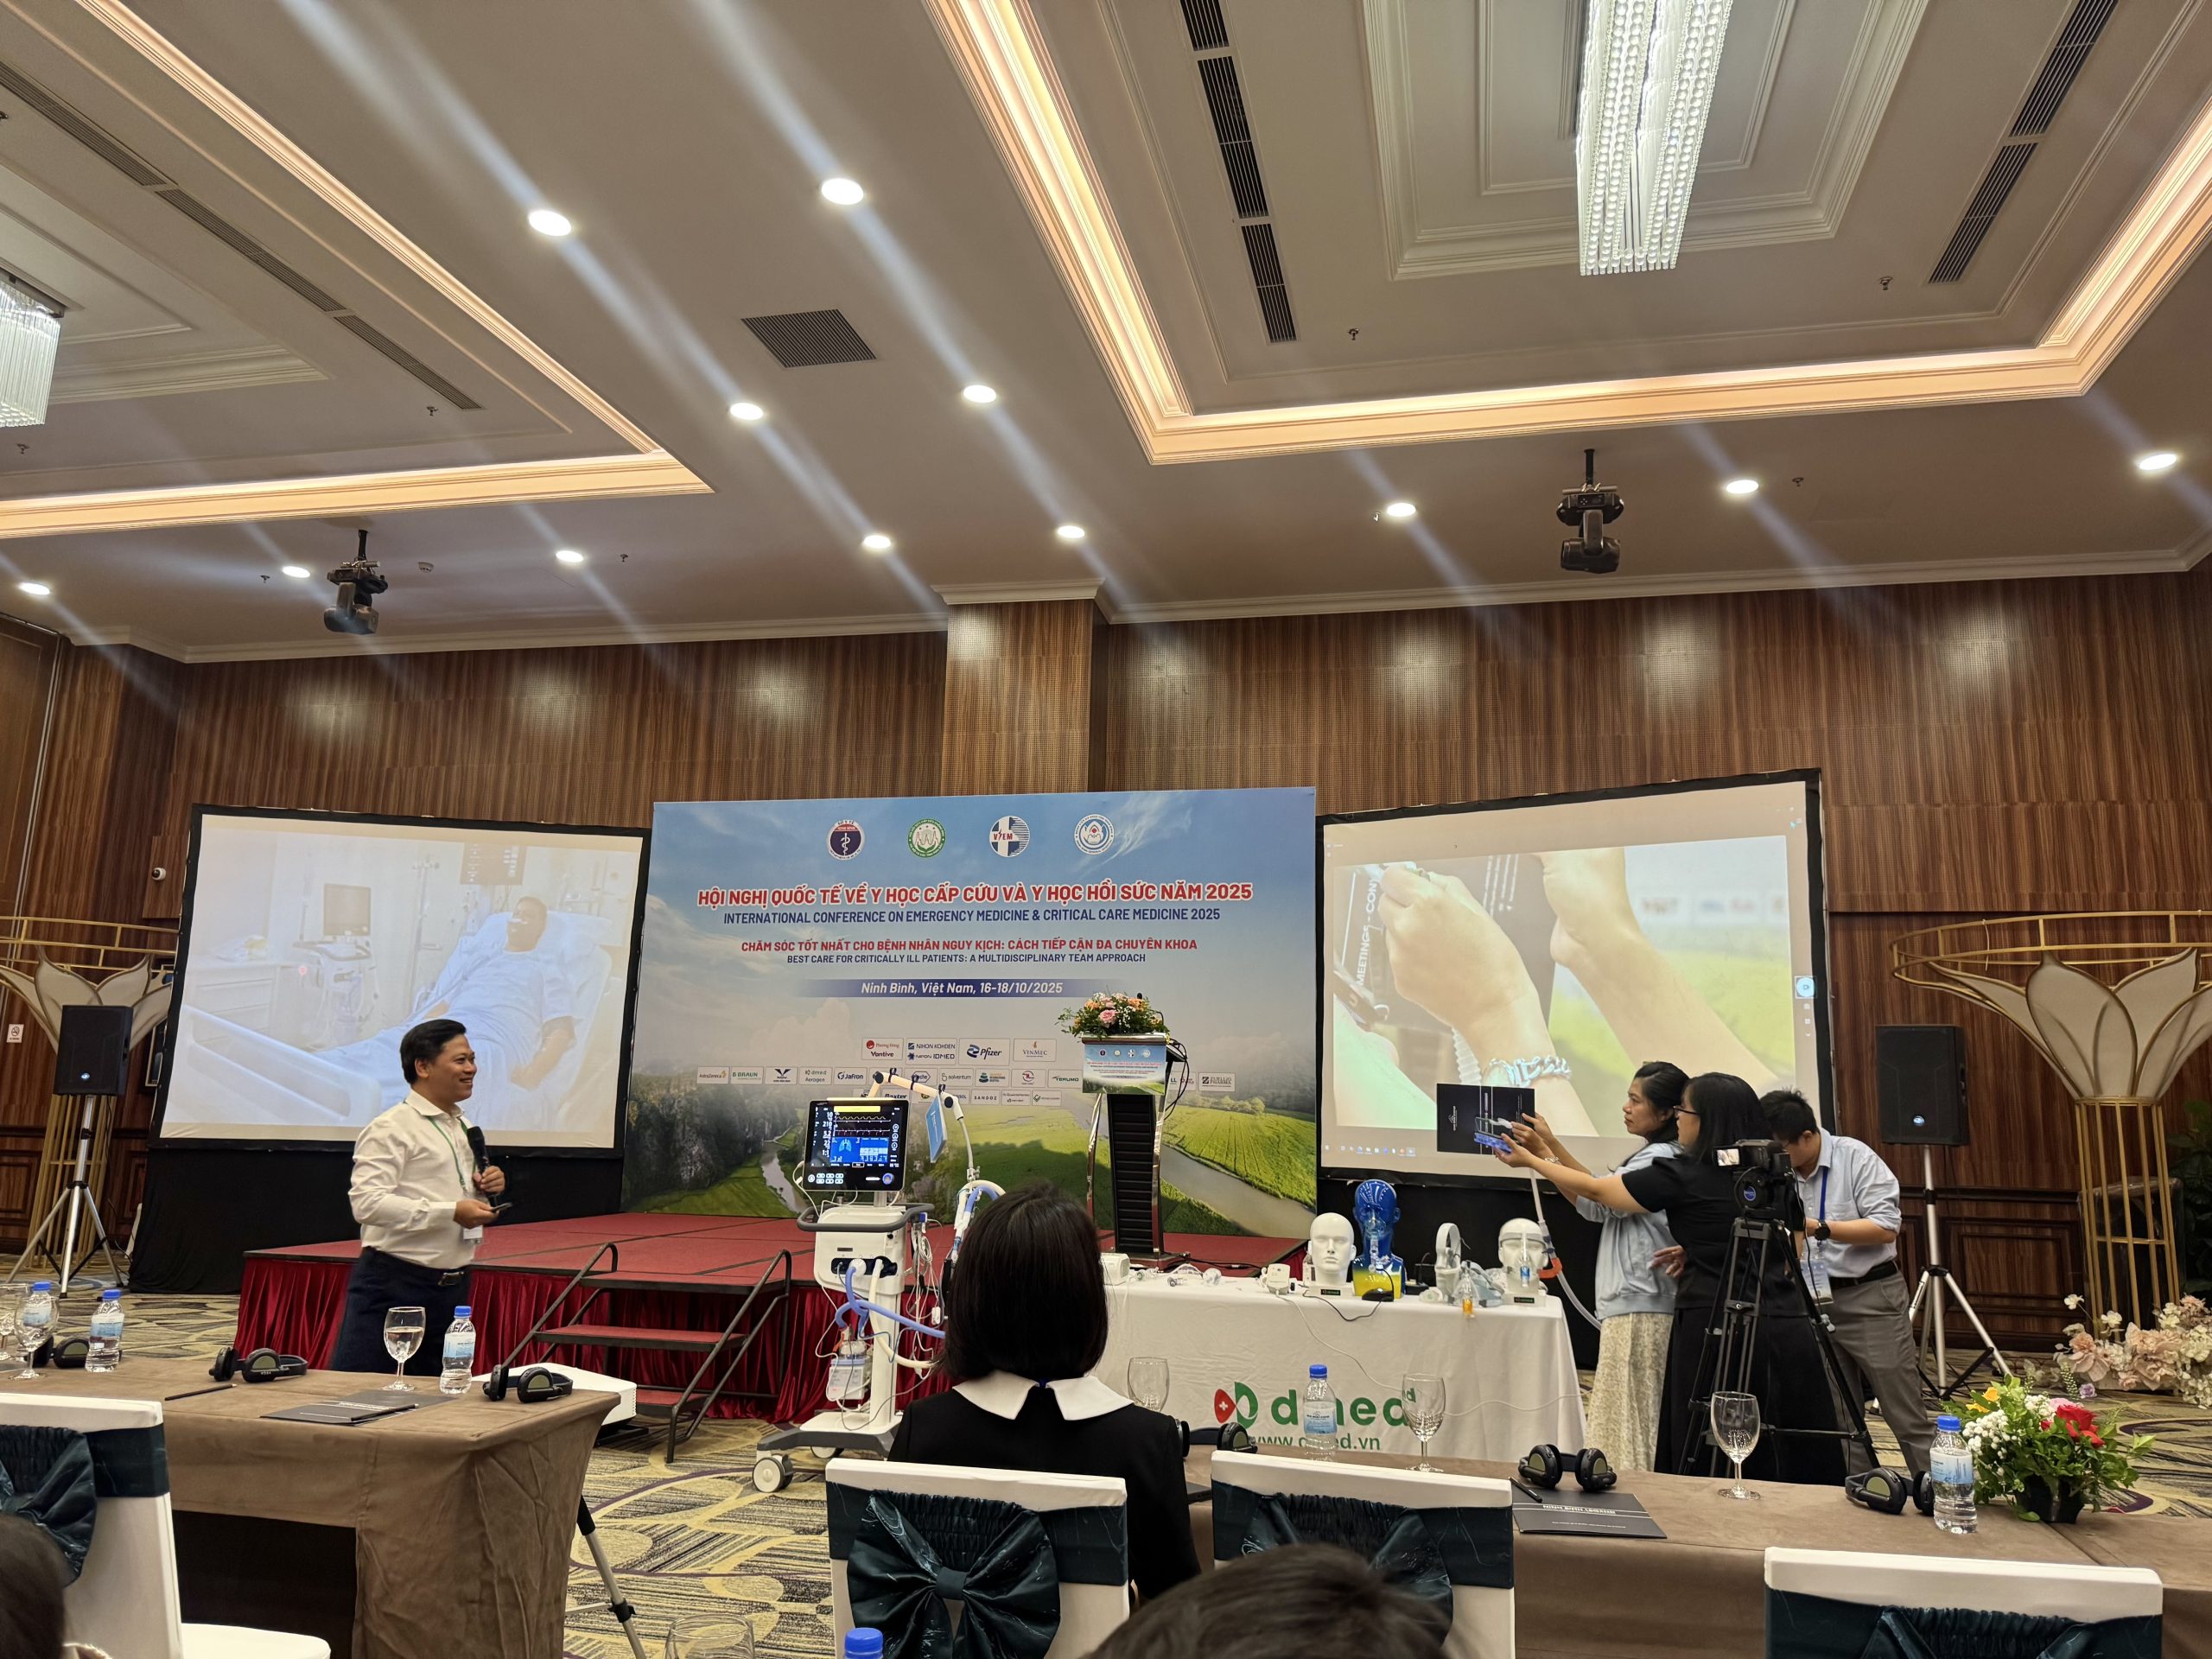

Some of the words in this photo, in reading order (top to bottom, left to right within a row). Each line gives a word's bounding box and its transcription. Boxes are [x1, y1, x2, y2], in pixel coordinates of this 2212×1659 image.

[698, 886, 724, 910] HỘI
[729, 889, 768, 910] NGHỊ
[771, 884, 816, 907] QUỐC
[819, 883, 843, 905] TẾ
[844, 880, 868, 905] VỀ
[870, 887, 882, 904] Y
[886, 887, 920, 908] HỌC
[924, 881, 959, 904] CẤP
[963, 882, 998, 903] CỨU
[1003, 881, 1027, 903] VÀ
[1032, 885, 1044, 902] Y
[1046, 885, 1083, 906] HỌC
[1087, 879, 1116, 902] HỒI
[1120, 880, 1157, 901] SỨC
[1160, 880, 1202, 901] NĂM
[1205, 883, 1253, 901] 2025
[723, 912, 810, 925] INTERNATIONAL
[813, 912, 886, 923] CONFERENCE
[888, 911, 904, 922] ON
[906, 910, 974, 922] EMERGENCY
[976, 910, 1029, 921] MEDICINE
[1032, 910, 1040, 921] &
[1043, 909, 1096, 921] CRITICAL
[1098, 909, 1129, 920] CARE
[1132, 909, 1188, 920] MEDICINE
[1191, 908, 1220, 919] 2025
[741, 940, 772, 951] CHĂM
[774, 941, 795, 951] SÓC
[798, 938, 818, 950] TỐT
[821, 938, 850, 950] NHẤT
[853, 941, 874, 950] CHO
[877, 939, 906, 953] BỆNH
[908, 939, 940, 950] NHÂN
[942, 940, 970, 950] NGUY
[976, 940, 1005, 952] KỊCH:
[1007, 938, 1039, 950] CÁCH
[1042, 937, 1066, 950] TIẾP
[1069, 938, 1093, 951] CẬN
[1096, 939, 1112, 949] ĐA
[1115, 938, 1162, 950] CHUYÊN
[1165, 939, 1197, 949] KHOA
[787, 955, 809, 963] BEST
[810, 955, 835, 963] CARE
[836, 955, 853, 963] FOR
[978, 954, 1066, 963] MULTIDISCIPLINARY
[861, 982, 887, 994] Ninh
[889, 982, 918, 995] Bình,
[922, 982, 944, 995] Việt
[947, 982, 976, 995] Nam,
[980, 982, 1064, 994] 16-18/10/2025
[980, 1046, 1002, 1060] Pfizer
[1271, 1389, 1410, 1427] ded
